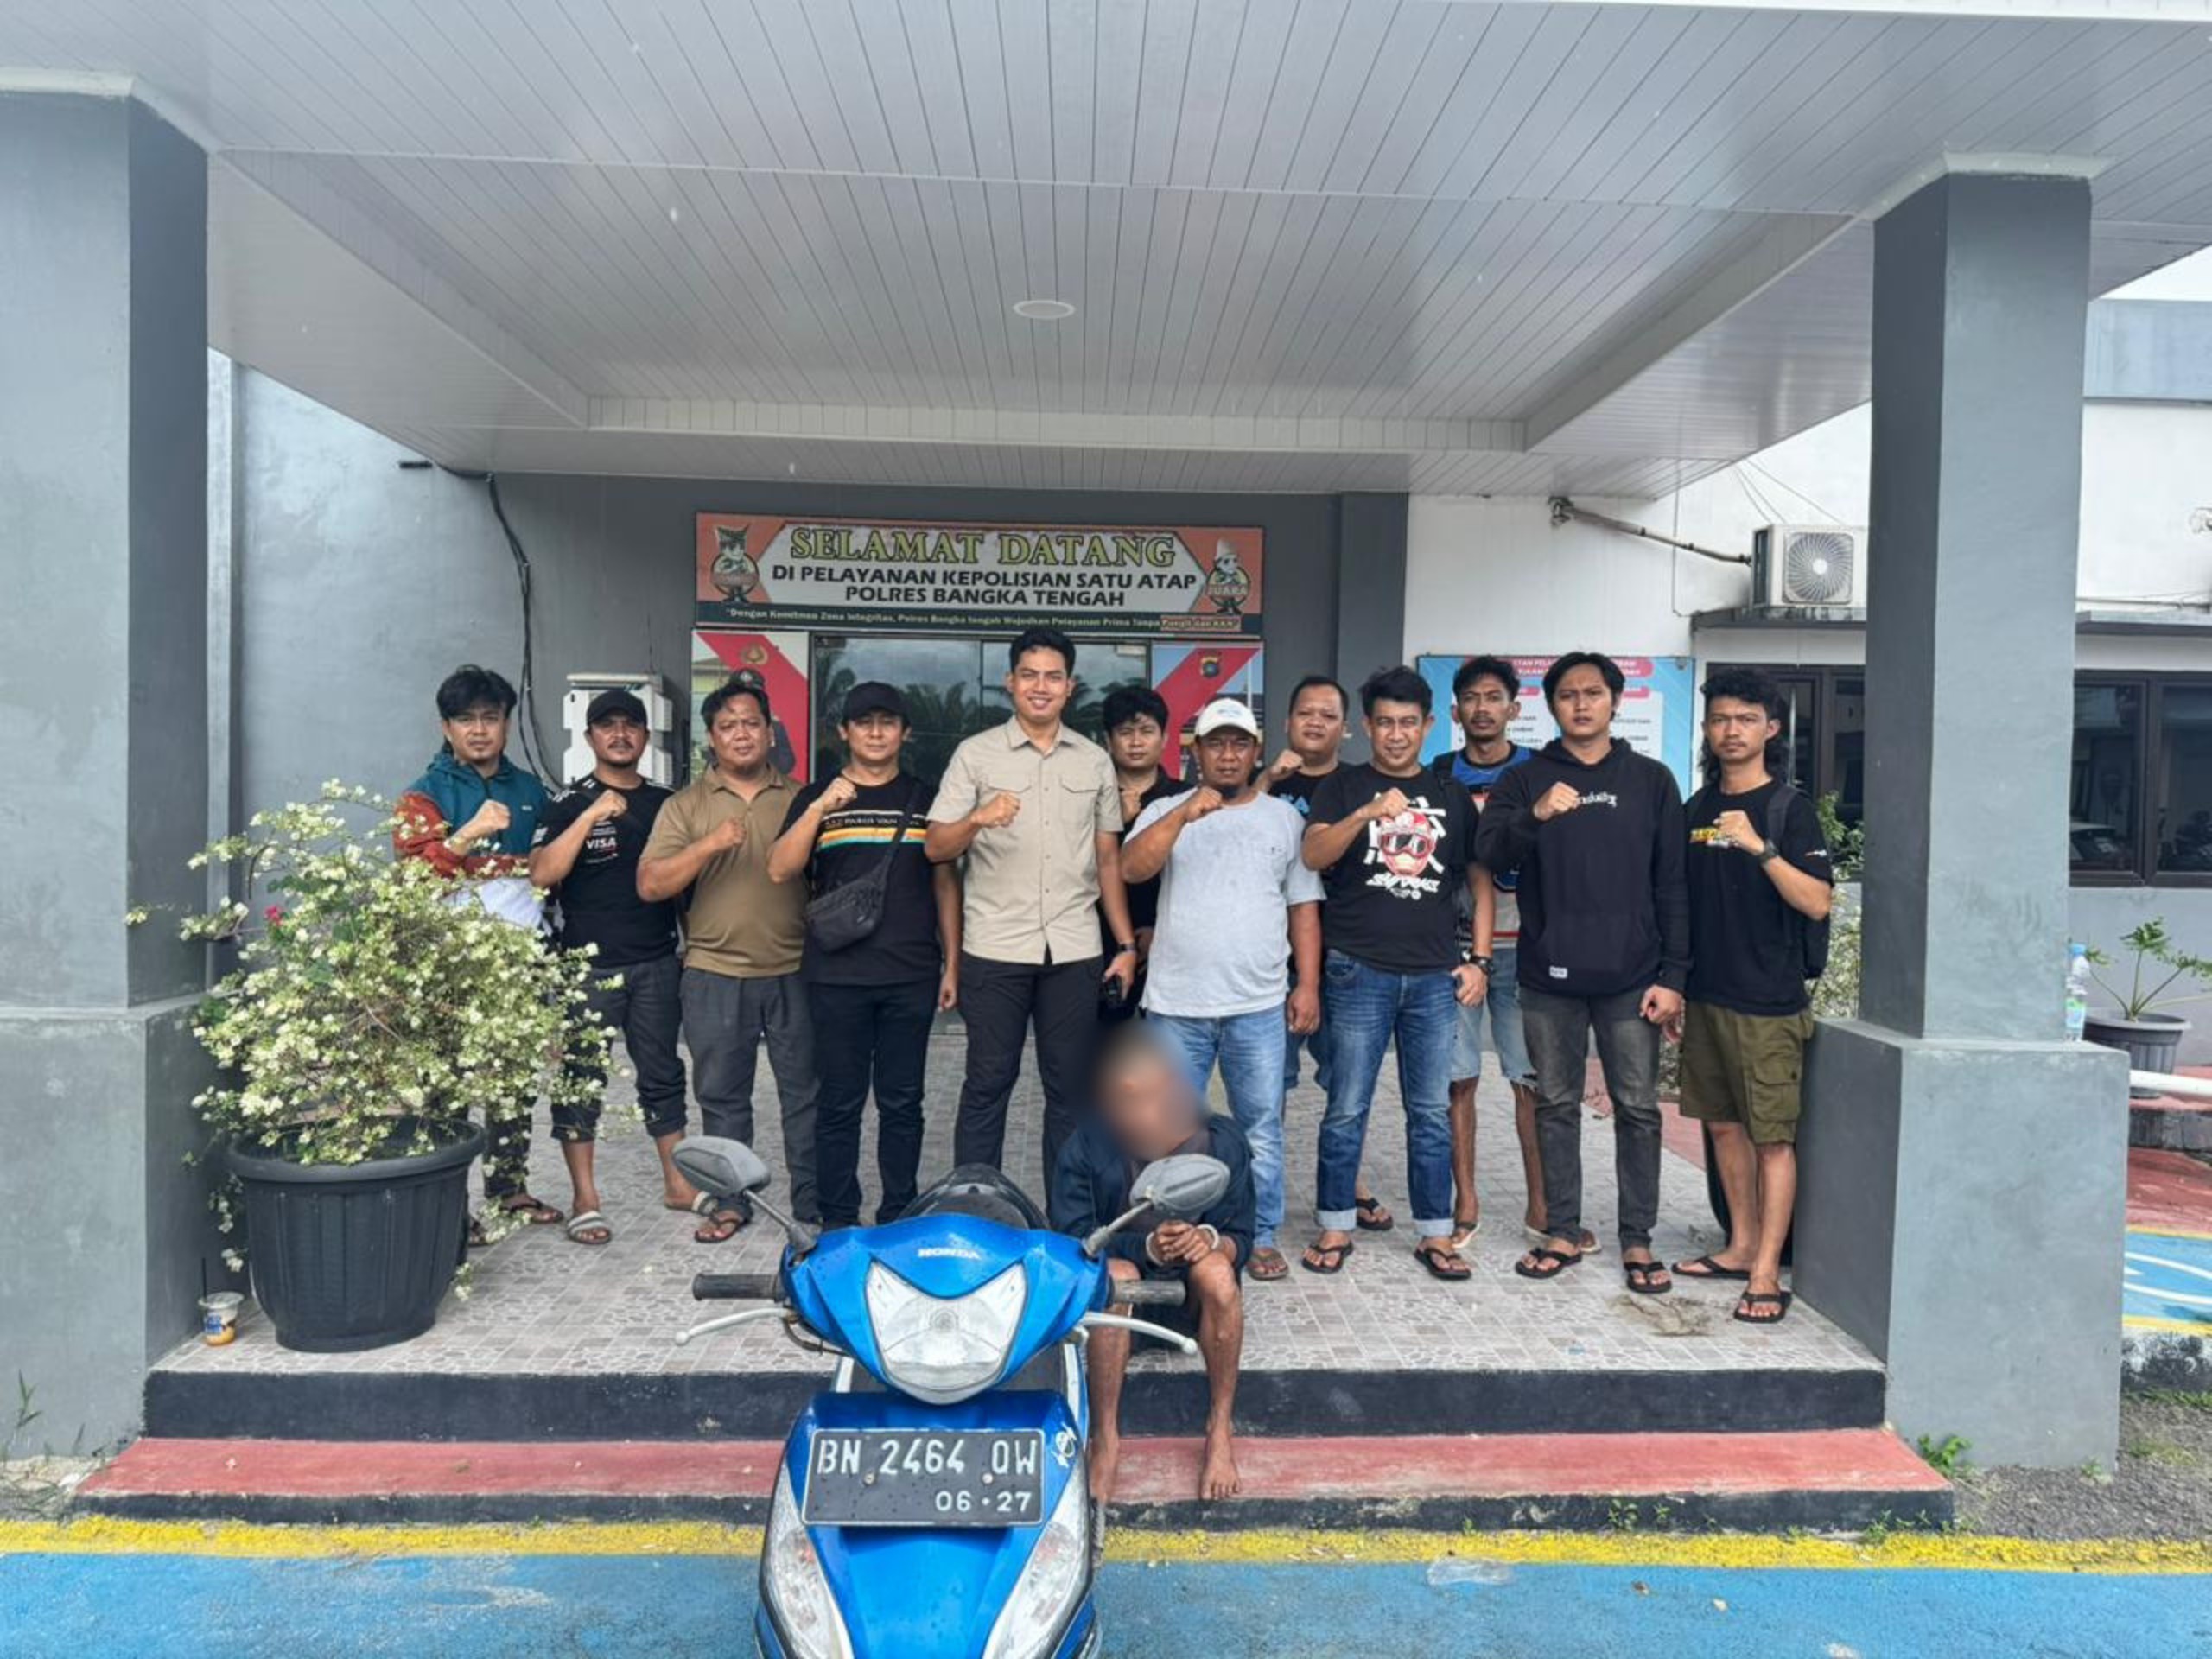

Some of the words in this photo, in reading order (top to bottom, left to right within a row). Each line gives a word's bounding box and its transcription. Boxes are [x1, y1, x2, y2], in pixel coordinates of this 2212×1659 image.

[791, 527, 984, 563] SELAMAT
[998, 533, 1176, 567] DATANG
[772, 565, 794, 581] DI
[801, 567, 935, 584] PELAYANAN
[943, 569, 1074, 588] KEPOLISIAN
[1077, 572, 1132, 588] SATU
[1135, 574, 1196, 589] ATAP
[846, 587, 926, 602] POLRES
[933, 588, 1027, 605] BANGKA
[1033, 590, 1124, 607] TENGAH
[586, 837, 616, 849] VISA
[918, 1247, 982, 1260] HONDA
[817, 1439, 861, 1475] BN
[880, 1438, 965, 1475] 2464
